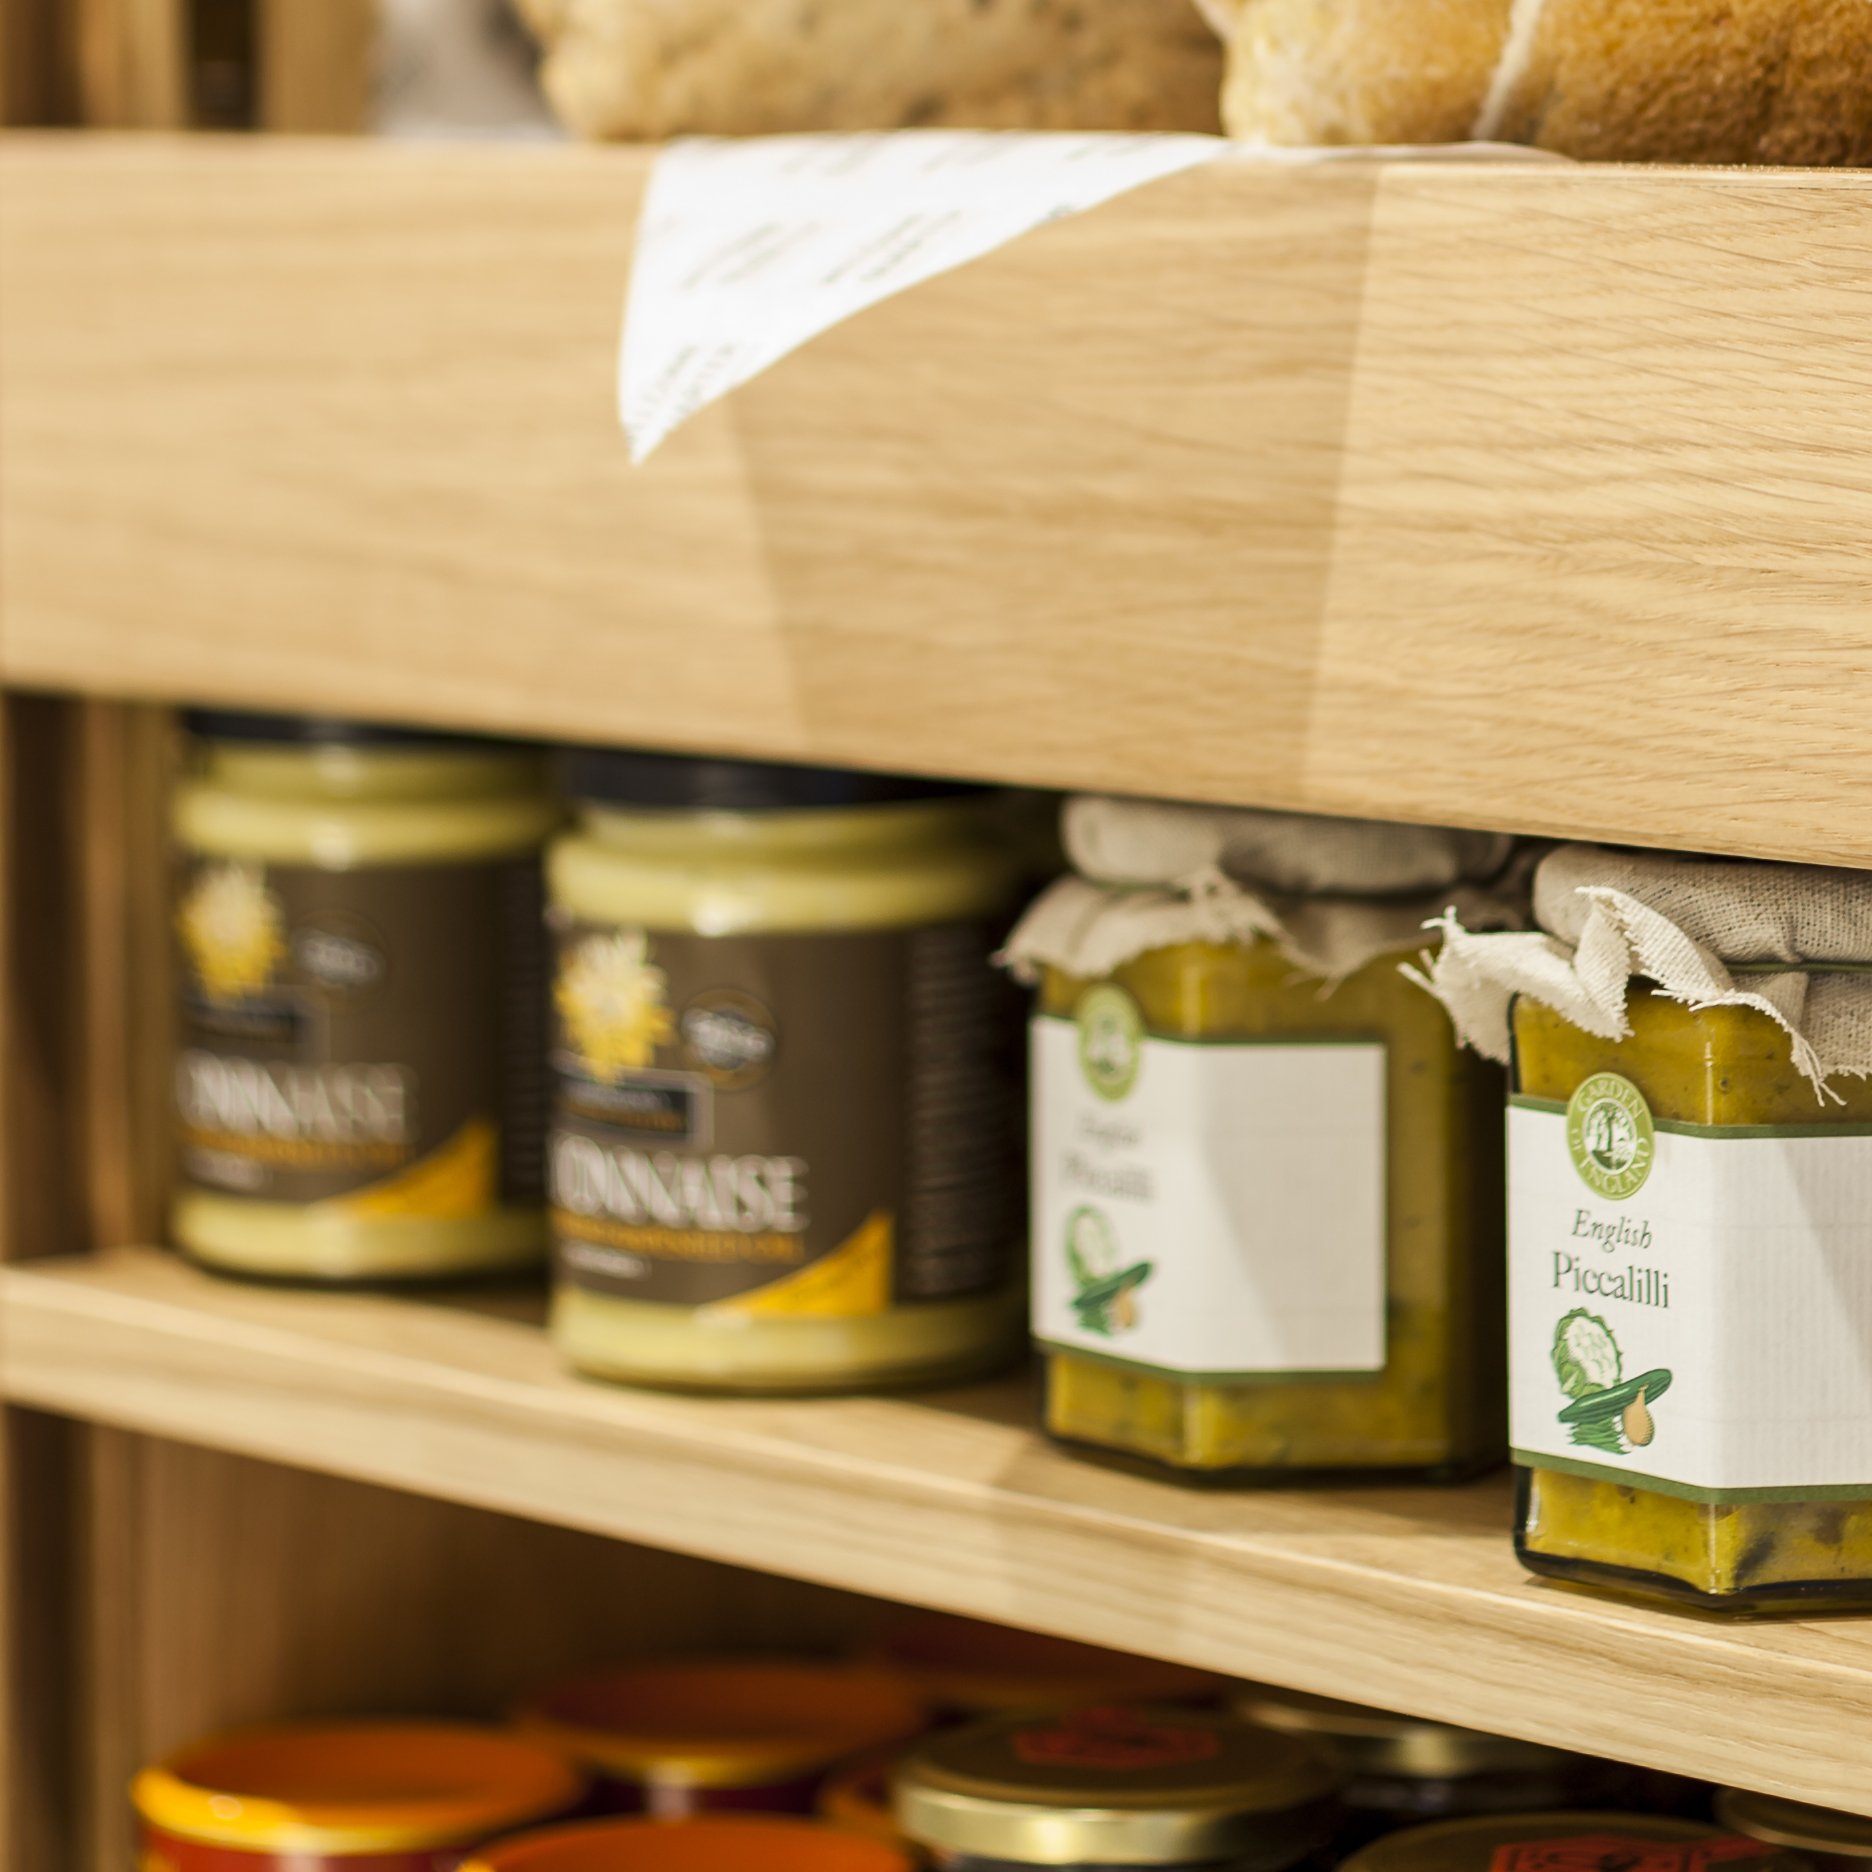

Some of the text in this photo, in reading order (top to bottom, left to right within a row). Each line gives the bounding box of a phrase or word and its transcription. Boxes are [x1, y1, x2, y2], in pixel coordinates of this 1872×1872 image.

[1577, 1079, 1645, 1118] GARDEN
[1579, 1136, 1651, 1194] ENGLAND
[1569, 1208, 1654, 1254] English
[1551, 1249, 1672, 1310] Piccalilli
